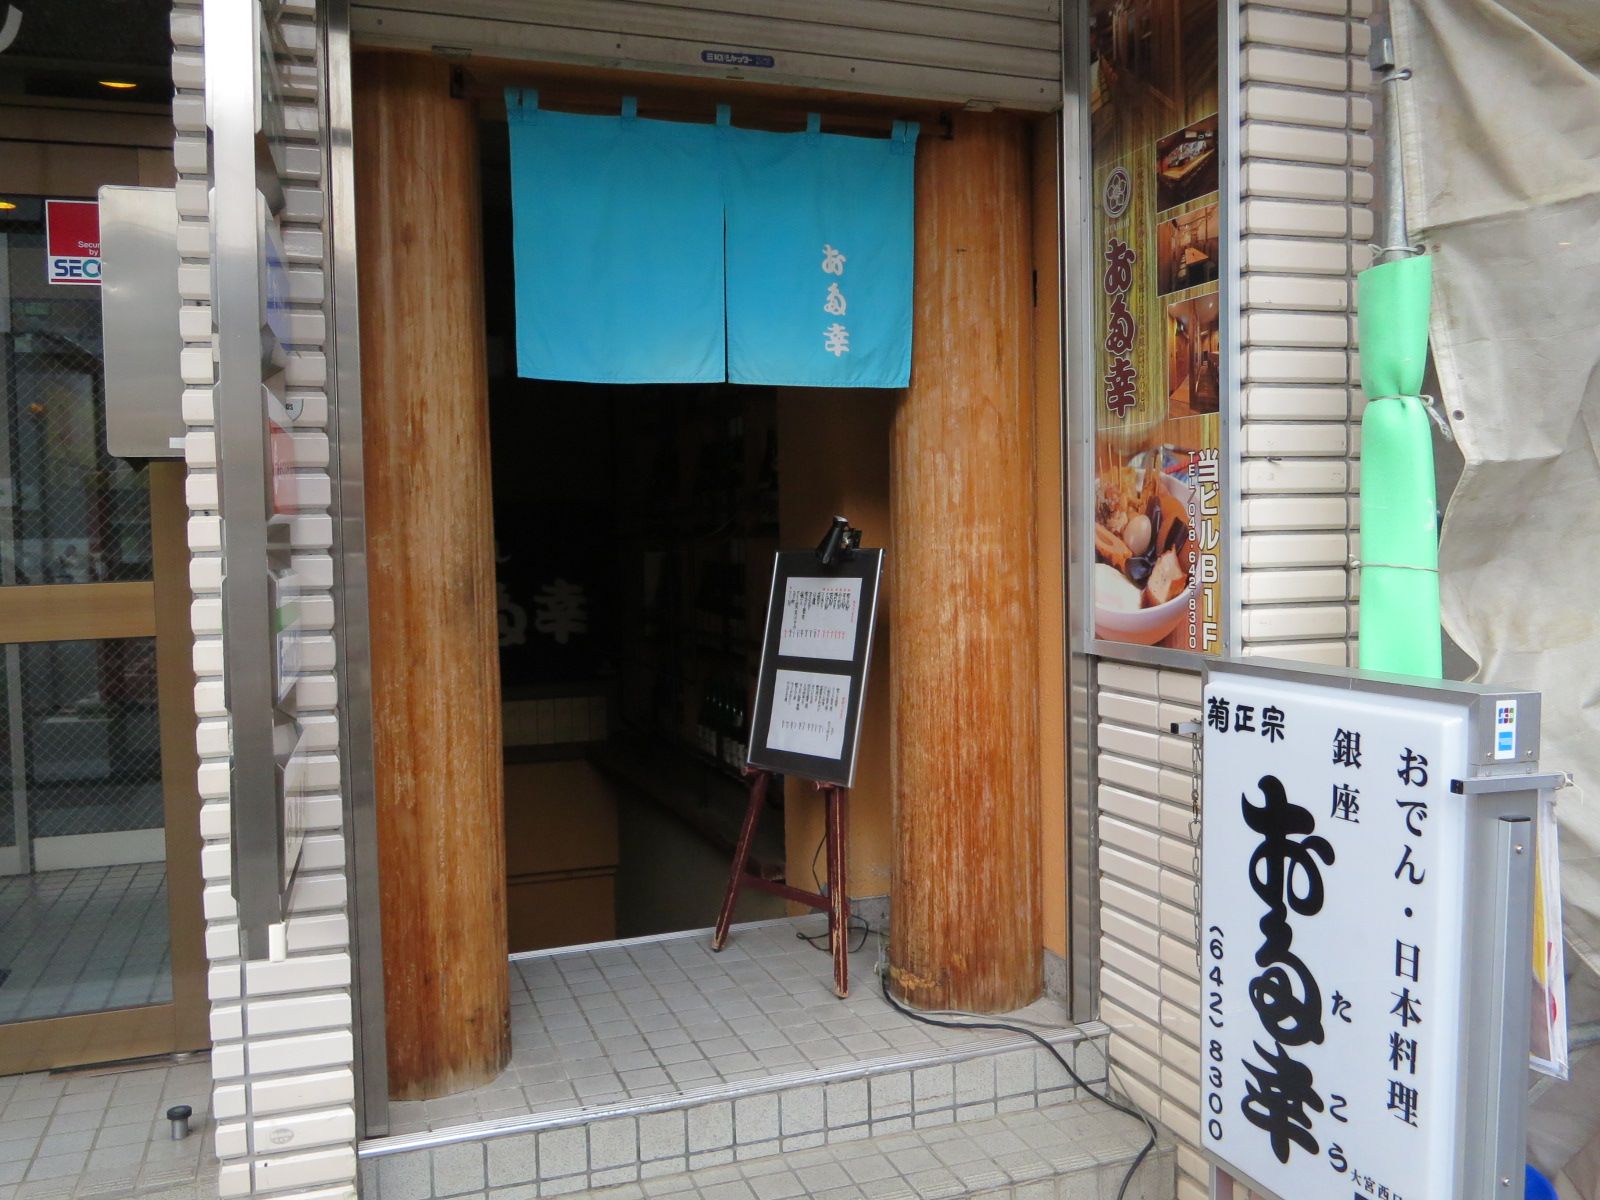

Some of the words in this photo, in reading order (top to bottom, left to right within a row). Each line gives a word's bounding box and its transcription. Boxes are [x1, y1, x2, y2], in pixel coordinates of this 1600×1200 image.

[54, 258, 101, 278] SEC
[1198, 448, 1220, 651] 当ビルB1F
[1207, 695, 1285, 743] 菊正宗
[1330, 727, 1362, 824] 銀座
[1386, 747, 1428, 1128] おでん・日本料理
